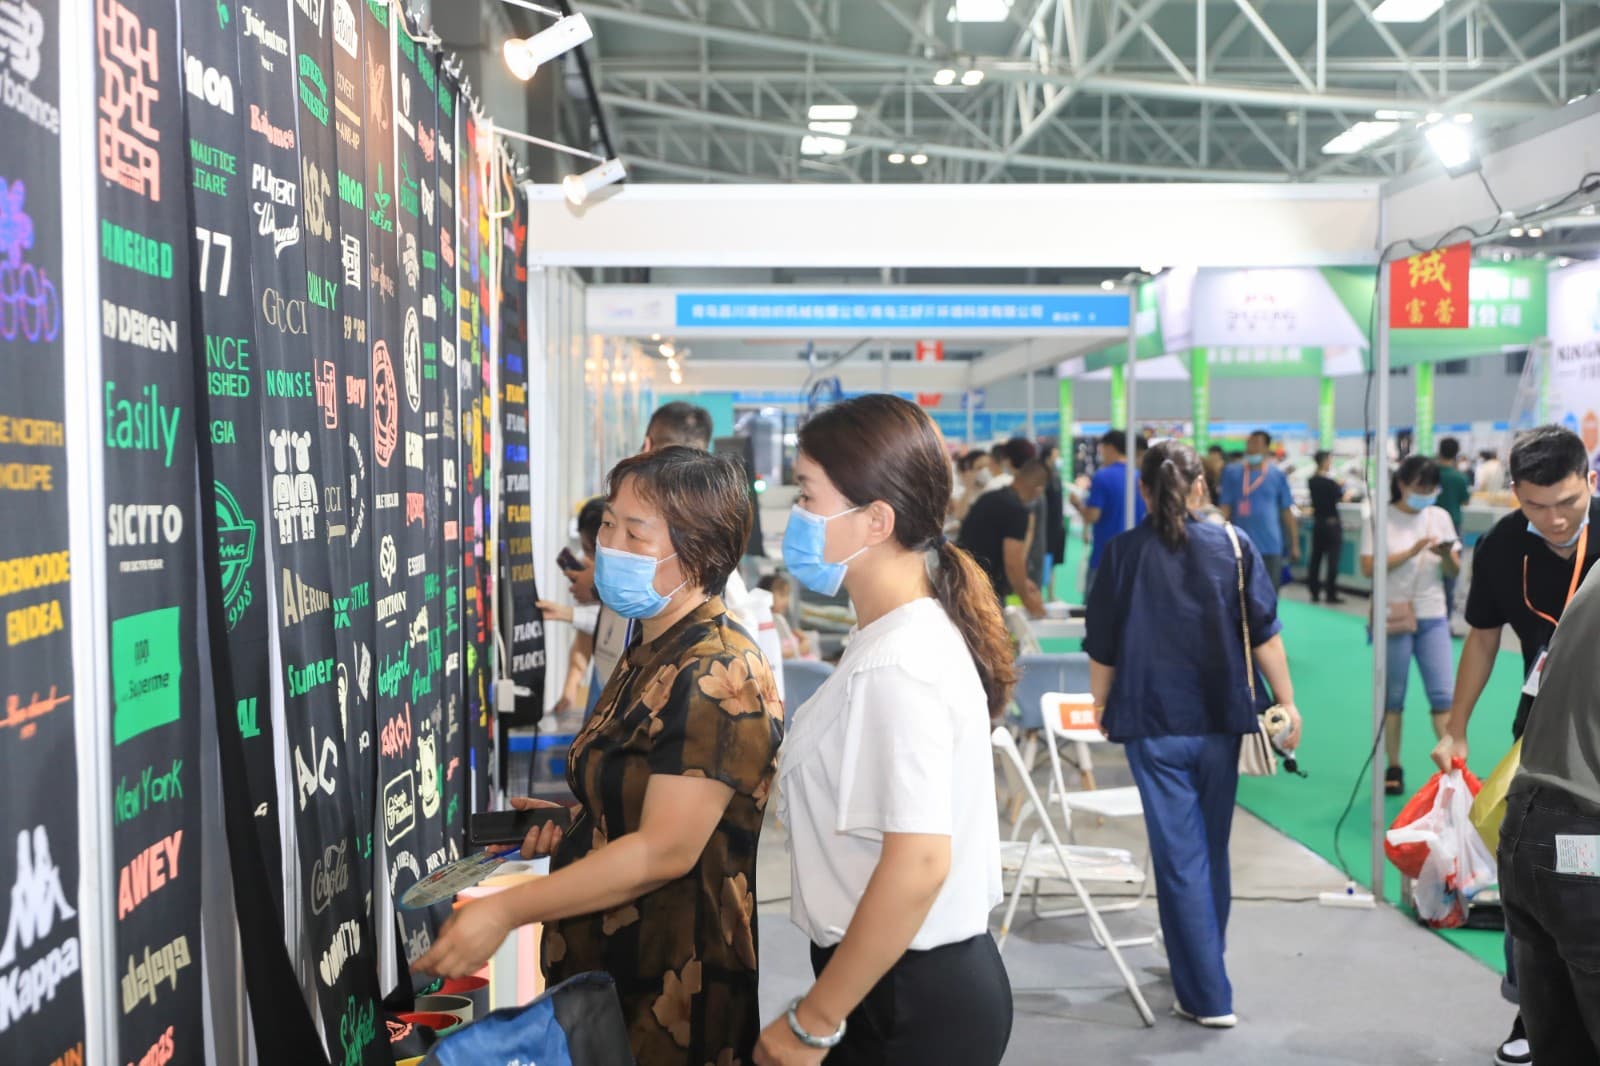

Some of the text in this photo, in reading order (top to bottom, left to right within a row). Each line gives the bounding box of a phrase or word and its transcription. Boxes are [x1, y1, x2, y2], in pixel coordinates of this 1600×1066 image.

[195, 226, 233, 297] 77
[105, 380, 182, 469] Easily
[117, 829, 184, 918] AWEY
[0, 936, 80, 1033] Kappa
